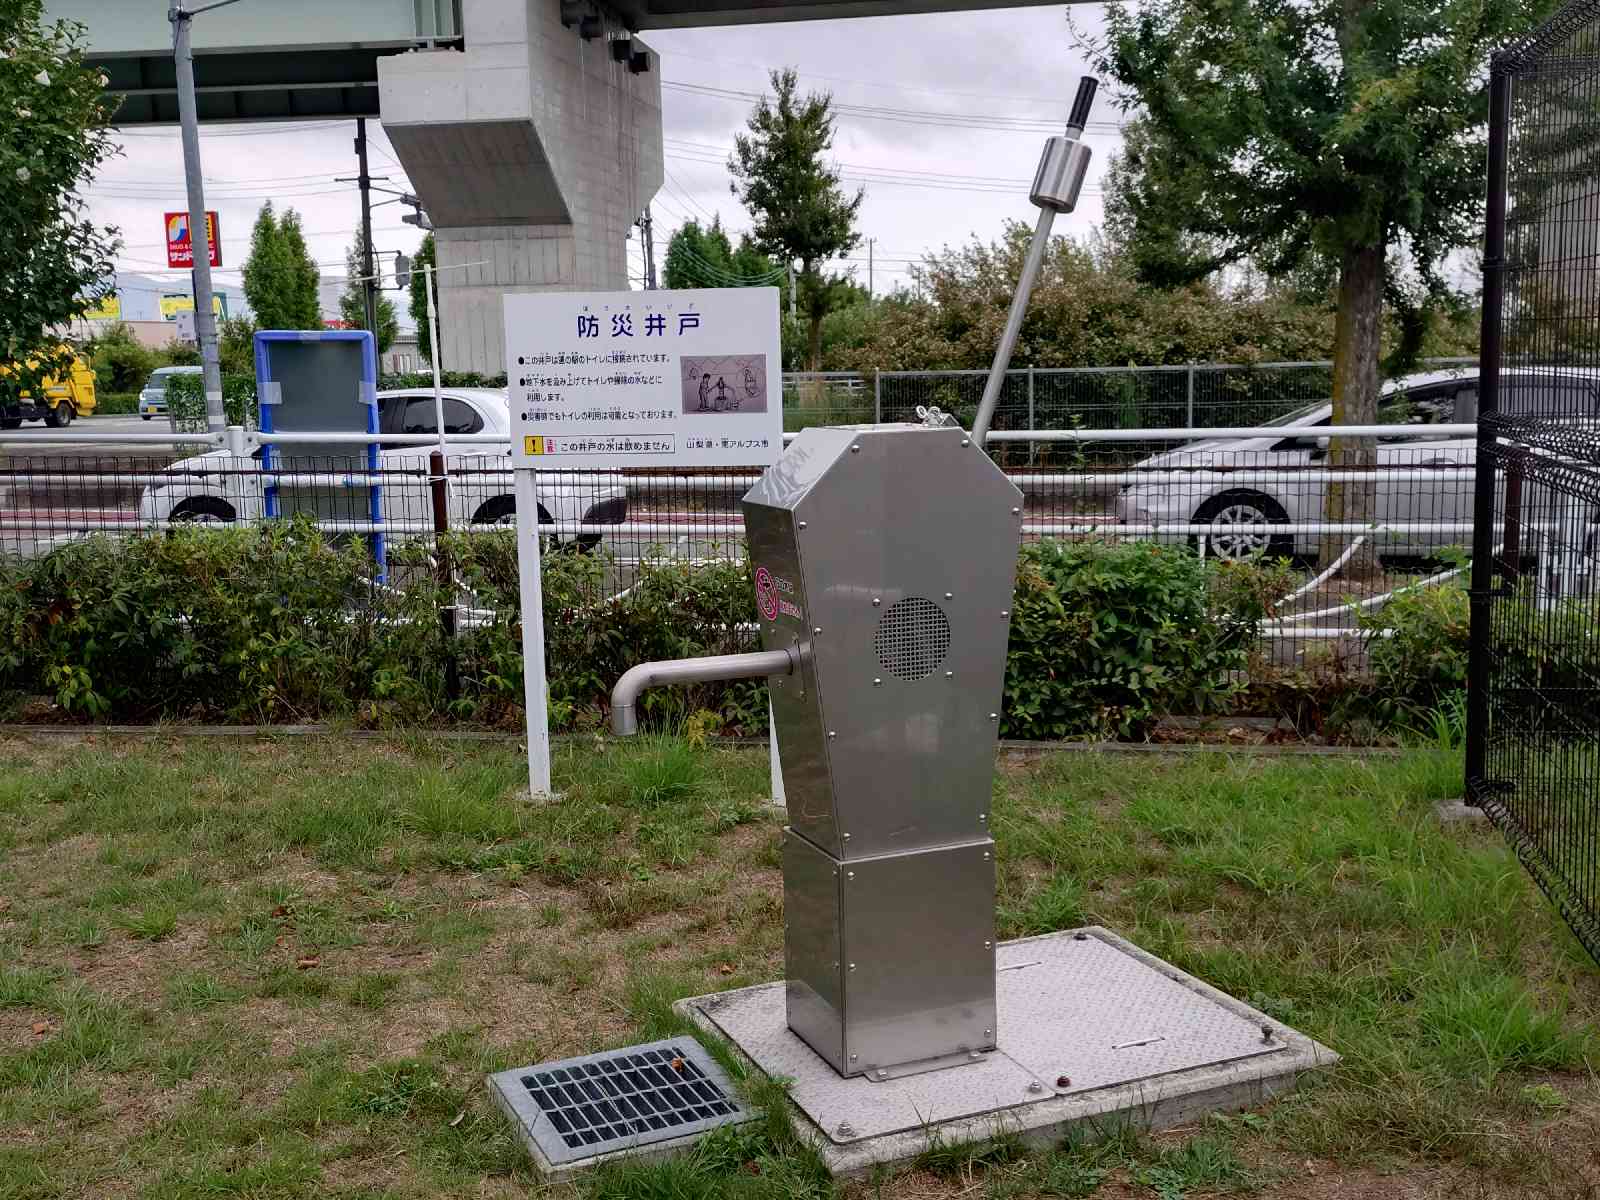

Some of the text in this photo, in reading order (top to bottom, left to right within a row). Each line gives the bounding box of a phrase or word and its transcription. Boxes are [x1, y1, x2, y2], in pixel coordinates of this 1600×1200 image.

[577, 312, 701, 337] 防災井戸
[560, 440, 671, 452] この井戸の水は飲めません
